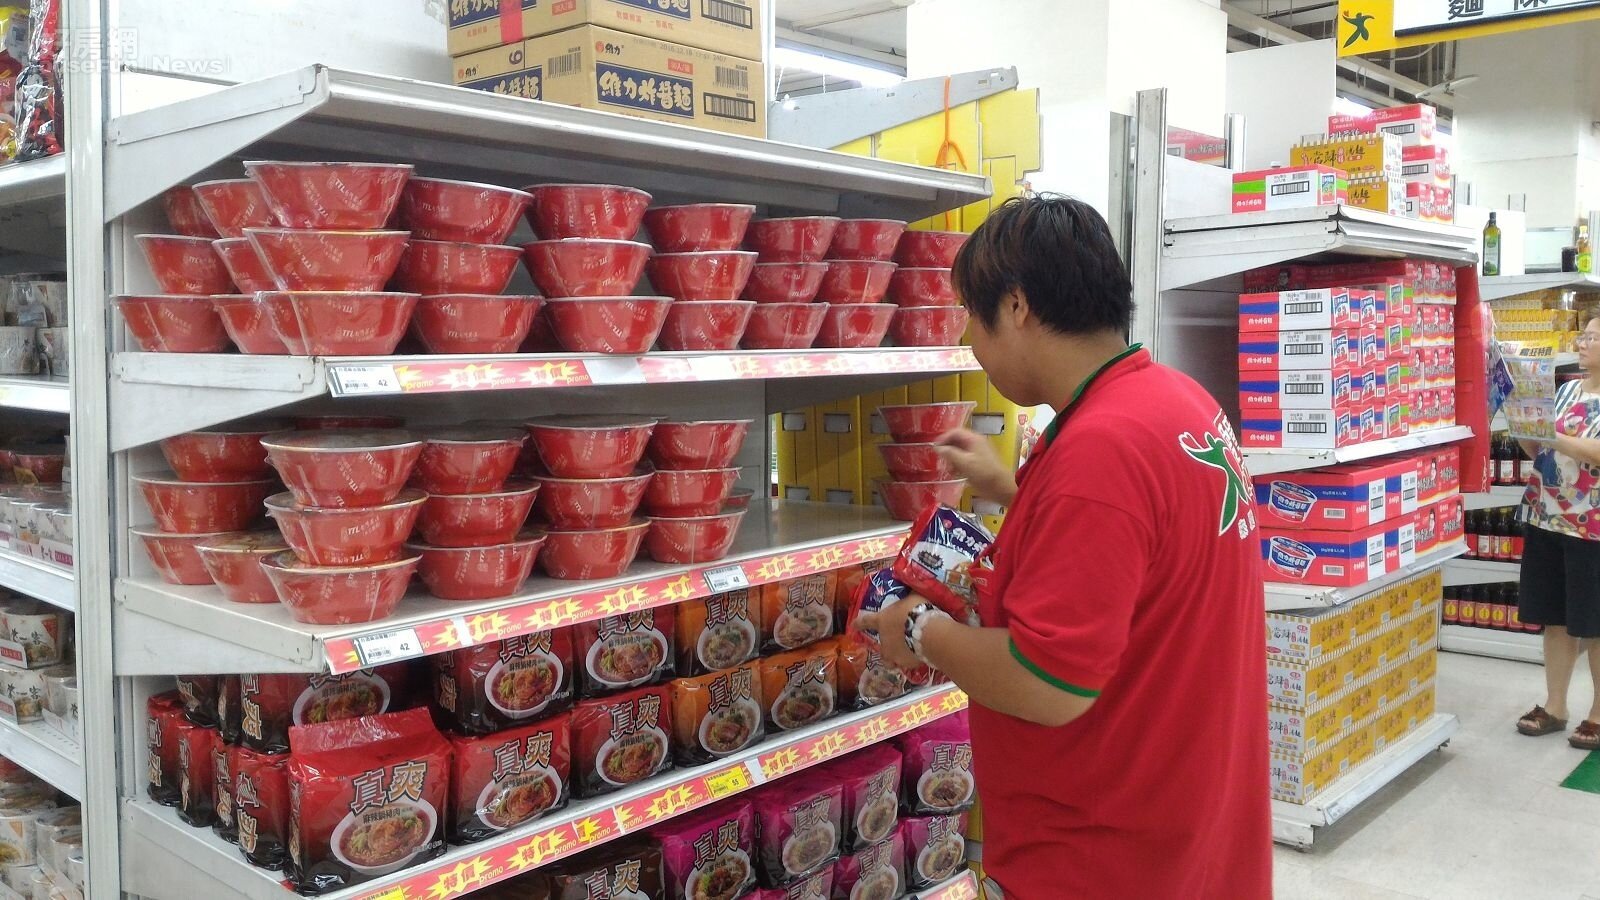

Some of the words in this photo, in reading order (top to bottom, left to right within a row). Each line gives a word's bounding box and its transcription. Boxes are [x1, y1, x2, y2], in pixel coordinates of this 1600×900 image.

[598, 70, 692, 111] 維力炸醬麵
[405, 378, 434, 393] promo
[491, 376, 517, 389] promo
[566, 373, 590, 385] promo
[766, 556, 789, 576] 特價
[816, 550, 837, 566] 特價
[704, 592, 749, 630] 真爽
[786, 574, 828, 611] 真爽
[497, 622, 523, 637] promo
[539, 605, 569, 622] 特價
[571, 607, 594, 622] promo
[609, 591, 637, 607] 特價
[638, 595, 659, 608] promo
[400, 642, 410, 651] 42
[708, 667, 752, 714] 真爽
[610, 694, 662, 741] 真爽
[493, 731, 554, 785] 真爽
[768, 752, 791, 773] 特價
[816, 735, 839, 754] 特價
[864, 720, 886, 739] 特價
[930, 743, 972, 773] 真爽
[349, 761, 428, 817] 真爽
[866, 765, 897, 805] 真爽
[794, 795, 832, 838] 真爽
[444, 863, 479, 891] 特價
[479, 864, 504, 887] promo
[521, 837, 555, 862] 特價
[554, 838, 578, 857] promo
[589, 826, 612, 844] promo
[622, 814, 644, 831] promo
[658, 793, 683, 813] 特價
[685, 794, 703, 810] promo
[694, 819, 740, 871] 真爽
[858, 840, 894, 881] 真爽
[585, 859, 642, 900] 真爽
